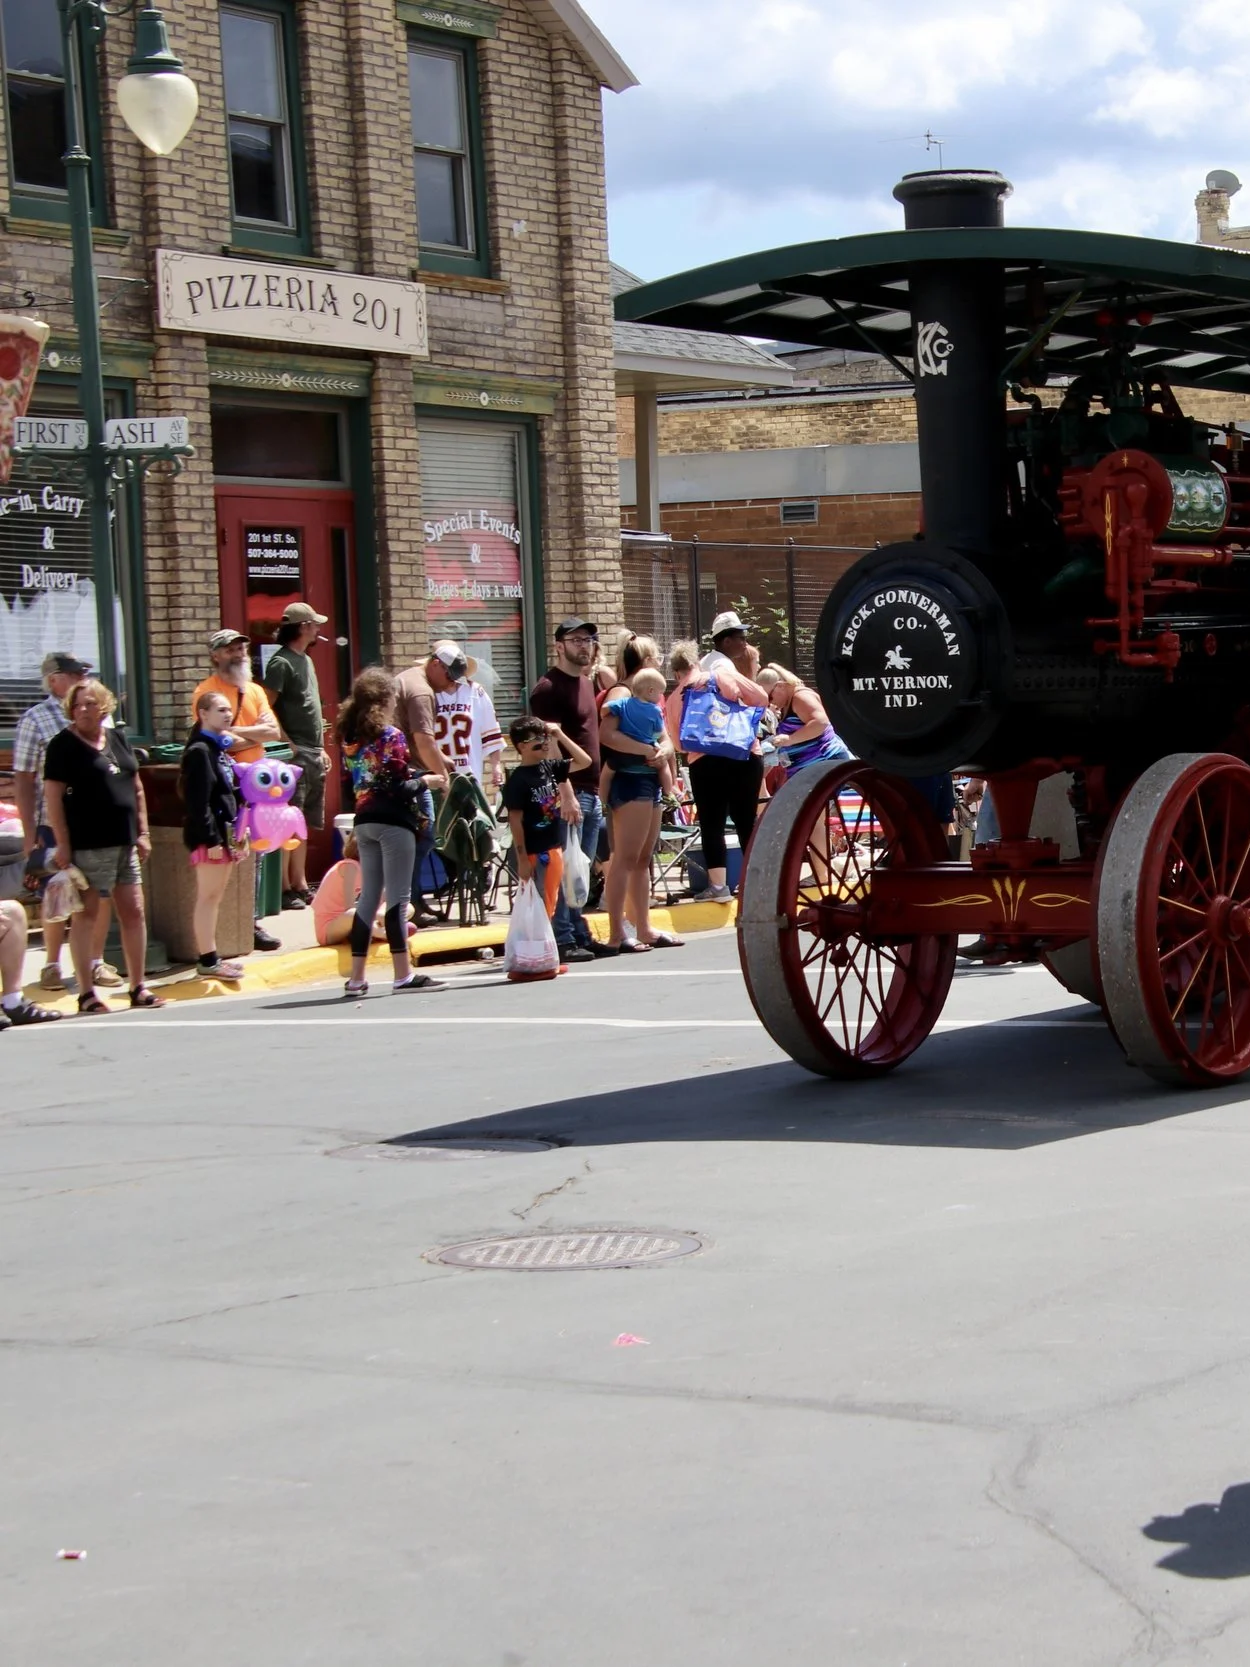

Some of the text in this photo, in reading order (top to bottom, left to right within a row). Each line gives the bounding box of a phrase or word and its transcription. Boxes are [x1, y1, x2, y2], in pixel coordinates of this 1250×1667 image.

[185, 275, 402, 337] PIZZERIA 201
[16, 421, 86, 444] FIRST ST
[78, 435, 85, 447] S
[111, 421, 184, 445] ASH AV
[171, 433, 184, 444] SE
[42, 486, 85, 518] Carry
[43, 526, 55, 550] &
[248, 533, 260, 543] 201
[261, 534, 271, 543] 1st
[424, 510, 521, 545] Special Events
[471, 543, 481, 564] &
[22, 564, 78, 589] Delivery
[427, 579, 459, 598] Parties
[471, 580, 491, 600] days
[503, 581, 523, 598] week
[842, 589, 960, 657] KECK, GONNERMAN
[893, 616, 927, 630] CO.,
[852, 675, 953, 691] MT. VERNON,
[885, 694, 923, 708] IND.
[433, 713, 473, 756] 22
